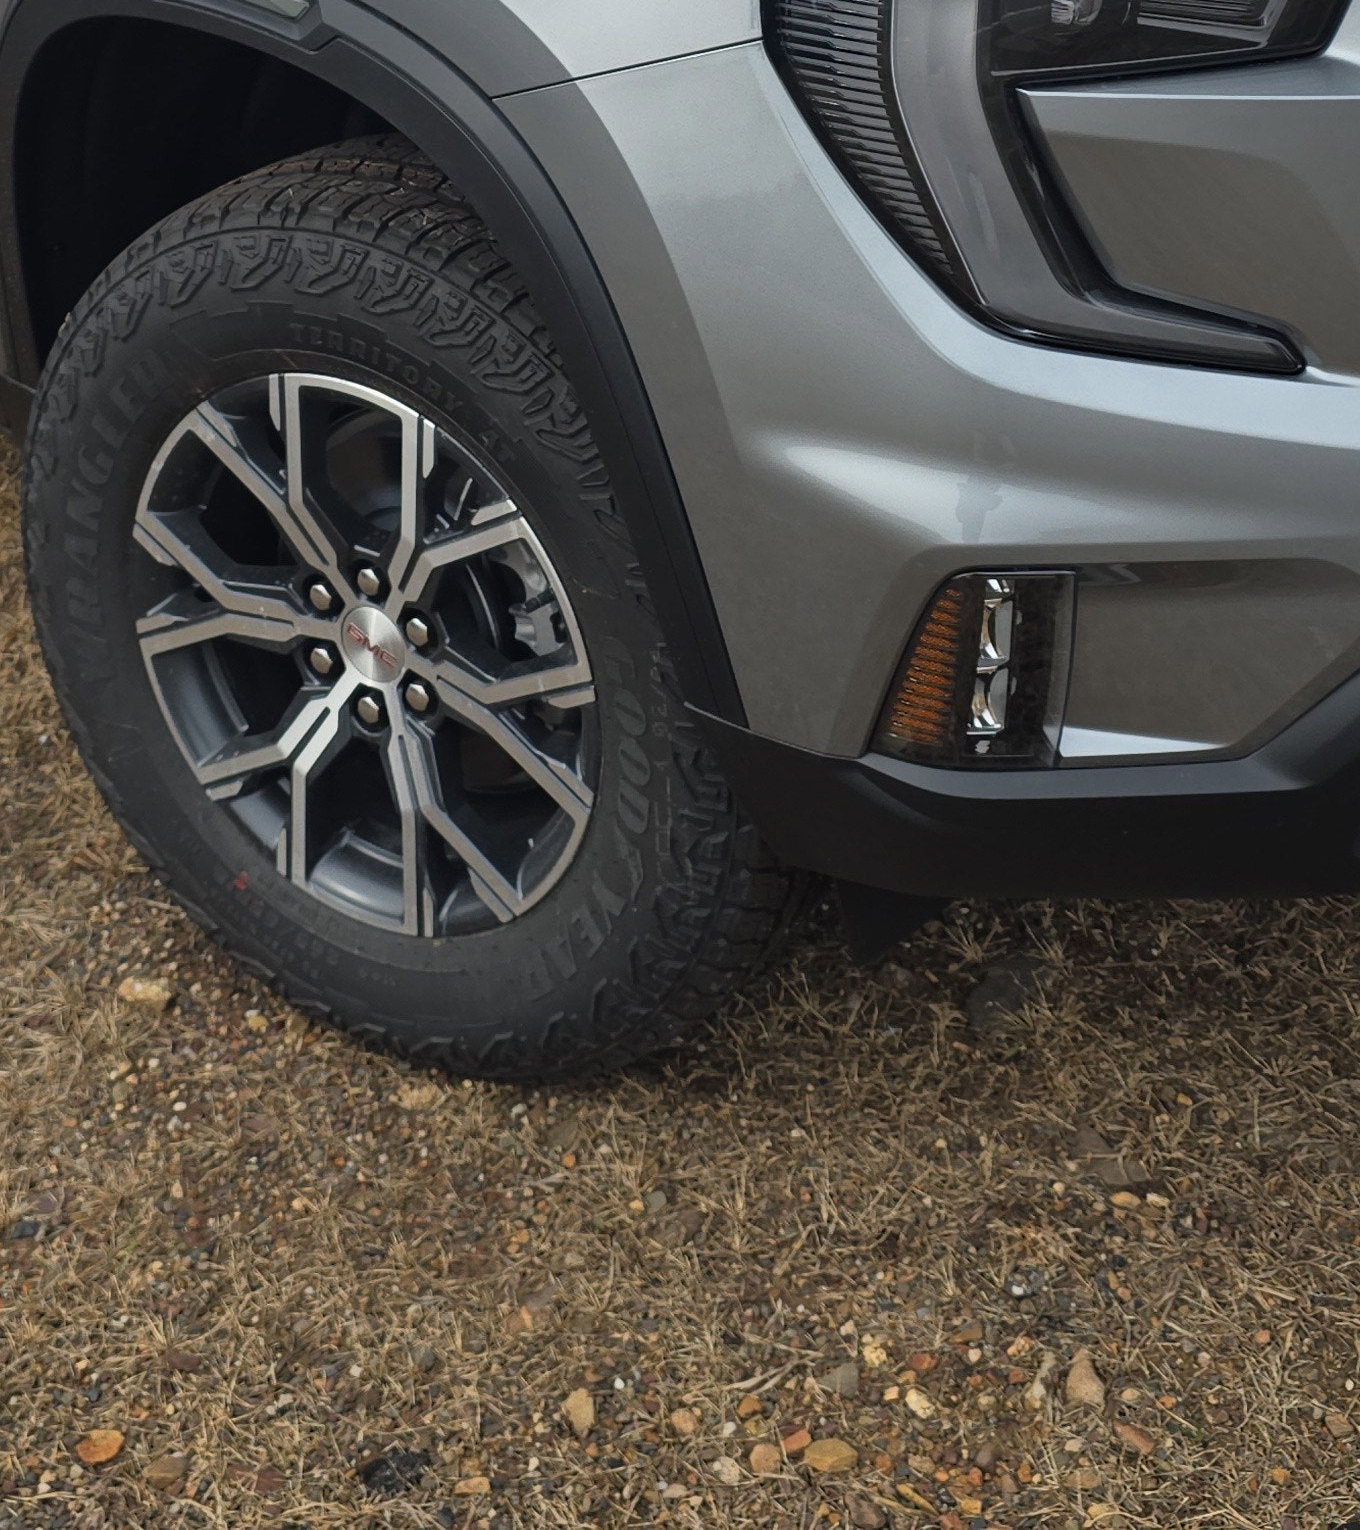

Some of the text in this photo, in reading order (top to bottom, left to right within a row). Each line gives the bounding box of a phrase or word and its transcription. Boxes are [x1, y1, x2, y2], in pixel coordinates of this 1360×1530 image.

[290, 322, 464, 411] TERRITORY
[346, 622, 398, 668] GMC
[523, 636, 652, 1000] GOODYEAR
